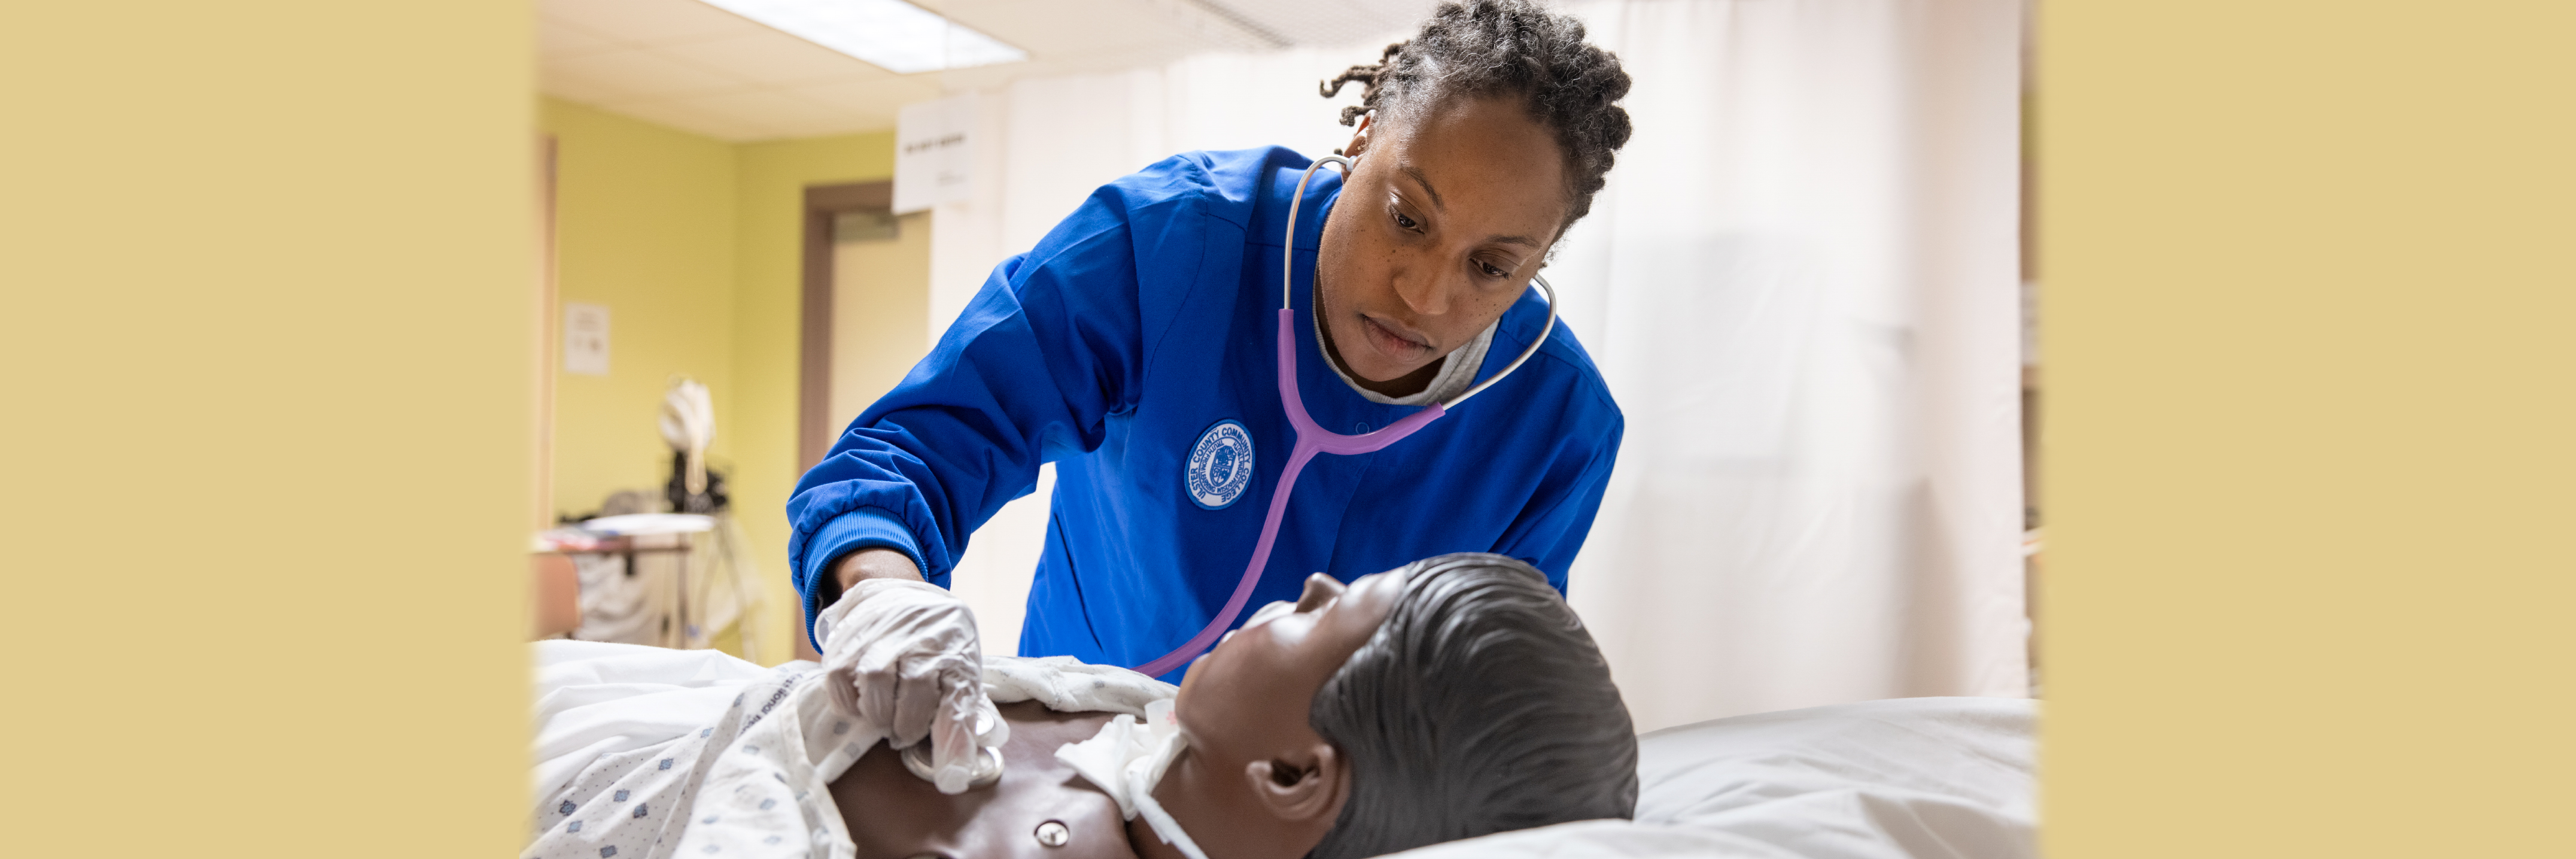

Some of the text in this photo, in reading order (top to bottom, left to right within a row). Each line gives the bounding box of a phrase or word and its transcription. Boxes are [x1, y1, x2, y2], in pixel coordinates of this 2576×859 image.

[1190, 427, 1251, 503] ULSTER COUNTY COMMUNITY COLLEGE
[1200, 440, 1225, 493] TRUTH FROM LEARNING
[1216, 478, 1237, 494] WISDOM
